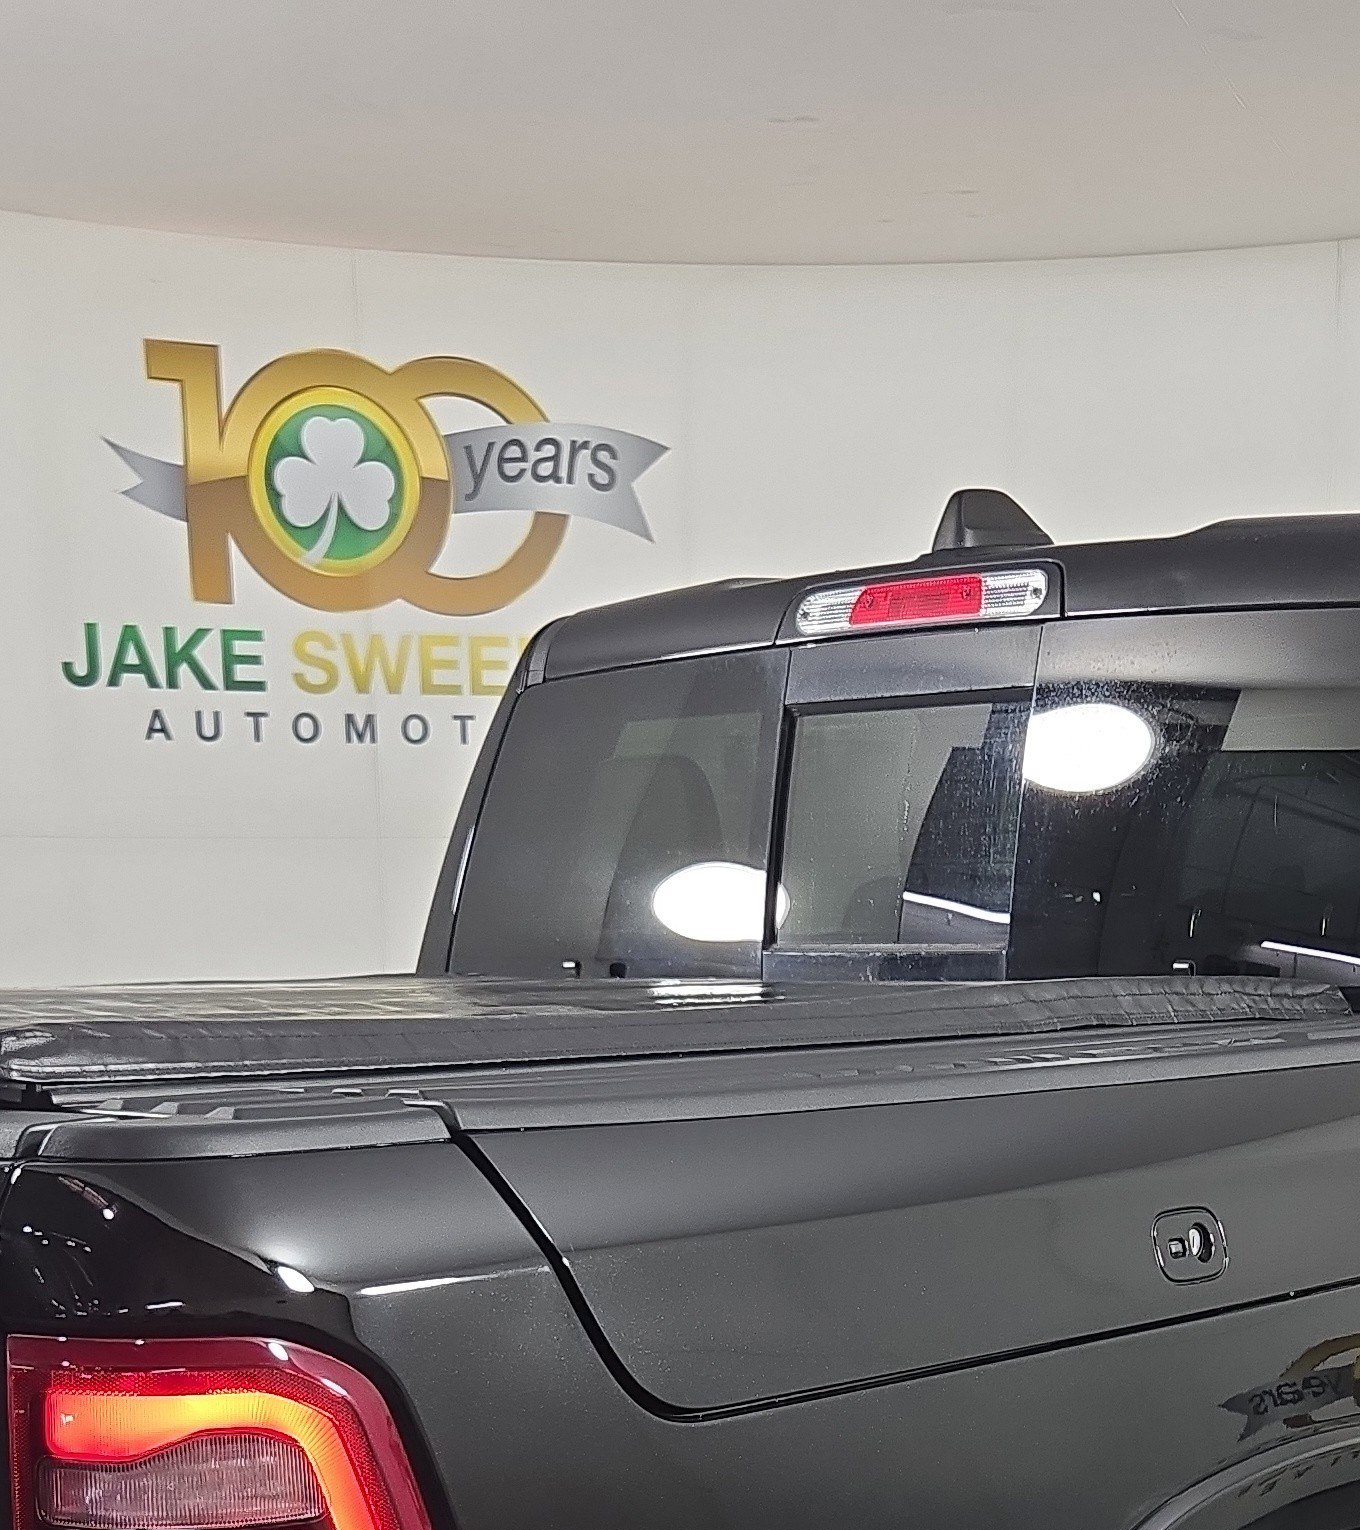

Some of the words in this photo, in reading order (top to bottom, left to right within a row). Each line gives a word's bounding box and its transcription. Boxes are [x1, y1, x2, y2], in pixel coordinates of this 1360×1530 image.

[142, 338, 572, 617] 100
[462, 435, 620, 502] years
[61, 621, 267, 692] JAKE
[292, 629, 529, 696] SWEE
